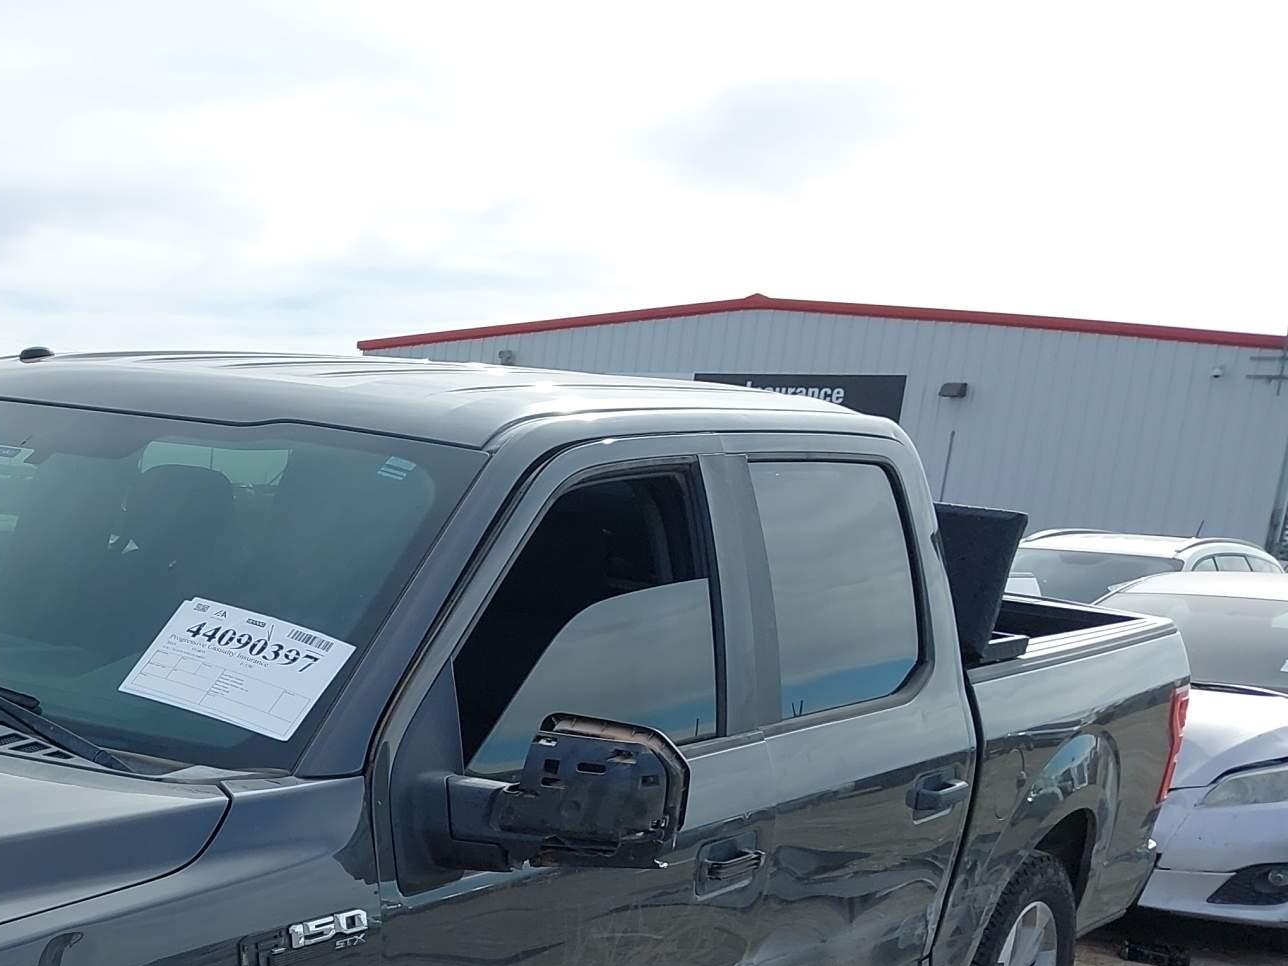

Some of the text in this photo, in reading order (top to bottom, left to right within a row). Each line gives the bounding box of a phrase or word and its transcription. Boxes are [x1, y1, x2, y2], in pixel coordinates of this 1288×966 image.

[186, 621, 321, 673] 44090397
[236, 652, 269, 668] Insurance
[335, 932, 367, 950] STX
